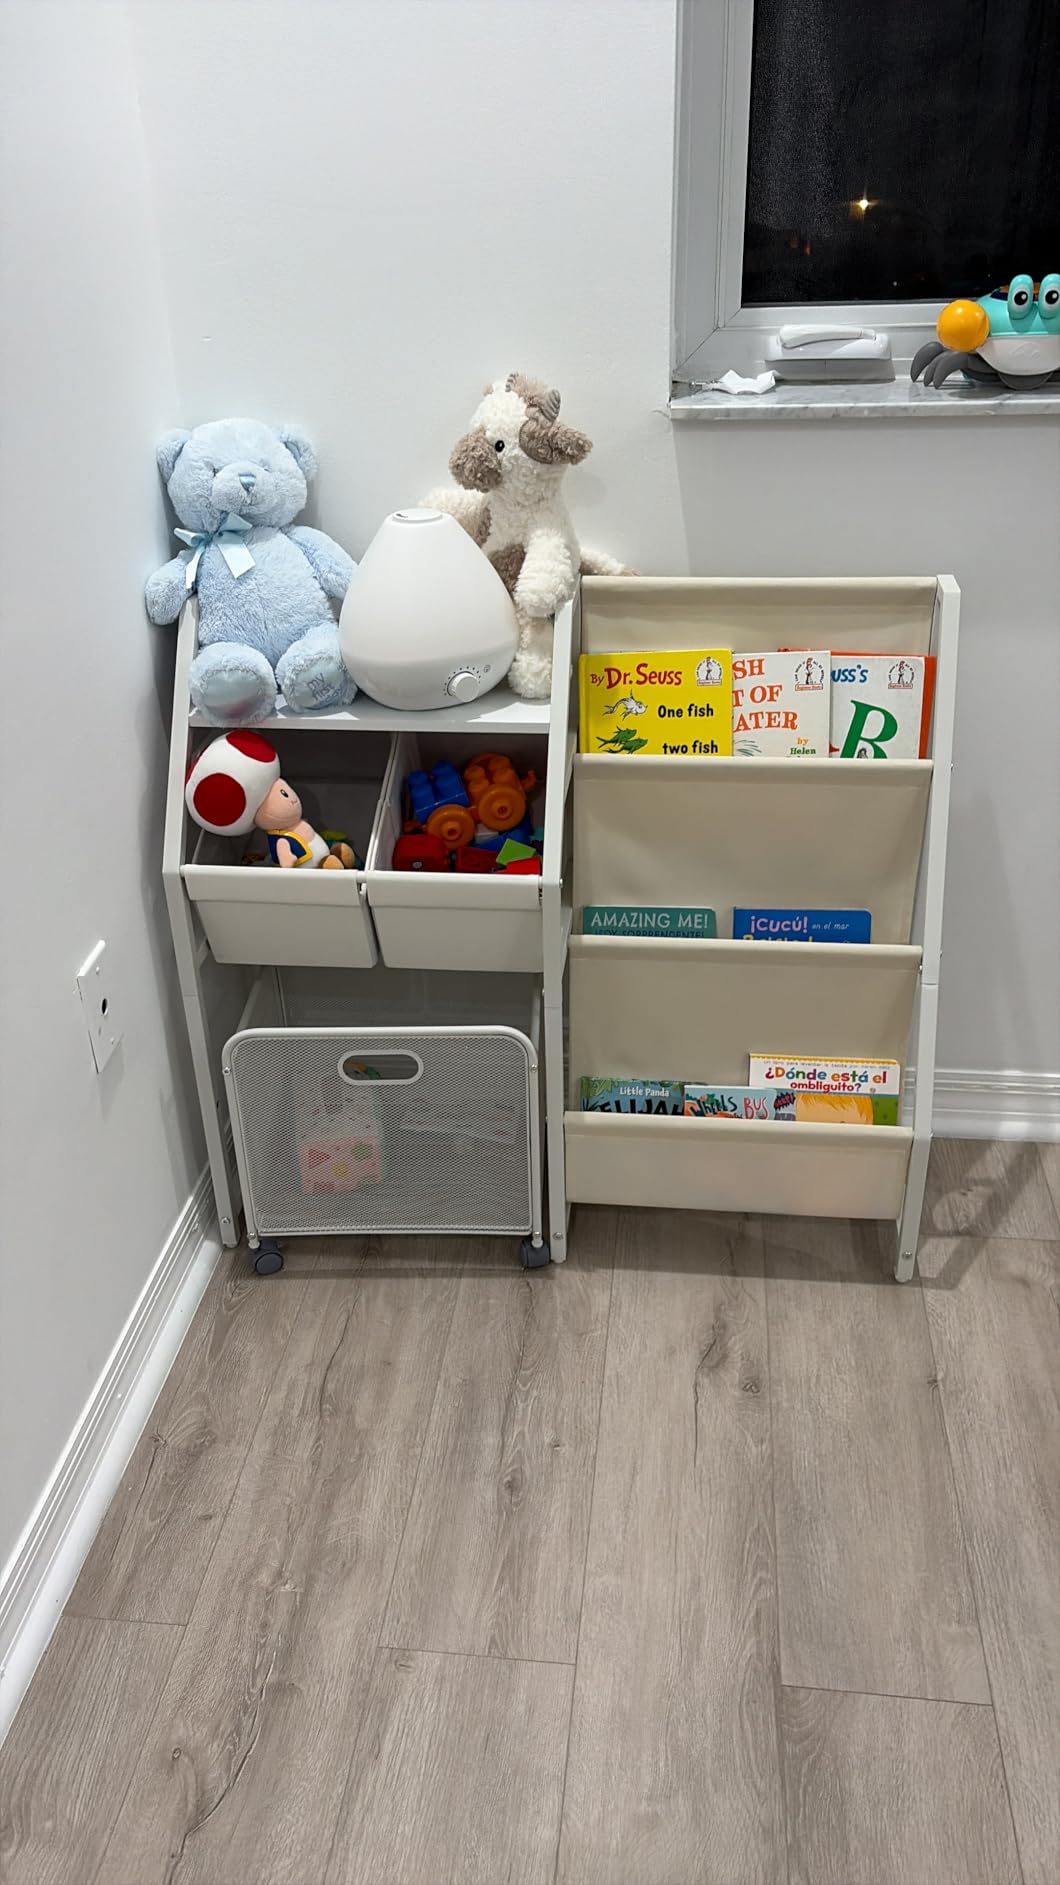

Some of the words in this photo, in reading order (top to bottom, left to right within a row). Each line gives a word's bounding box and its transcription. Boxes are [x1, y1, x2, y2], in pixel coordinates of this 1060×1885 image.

[590, 673, 605, 687] By
[604, 667, 633, 689] Dr.
[635, 663, 682, 686] Seuss
[732, 658, 765, 680] SH
[307, 673, 325, 690] my
[750, 685, 782, 704] OF
[657, 705, 683, 718] One
[688, 703, 714, 717] fish
[732, 711, 798, 733] ATER
[662, 743, 688, 754] two
[692, 740, 718, 754] fish
[797, 737, 809, 745] by
[790, 747, 816, 755] Helen
[591, 912, 670, 928] AMAZING
[678, 913, 708, 928] ME!
[750, 916, 808, 933] ¡Cucú!
[823, 921, 832, 930] el
[765, 1067, 827, 1080] ¿Dónde
[831, 1070, 868, 1083] está
[872, 1071, 887, 1084] el
[620, 1087, 643, 1096] Little
[645, 1088, 669, 1097] Panda
[790, 1081, 862, 1094] ombliguito?
